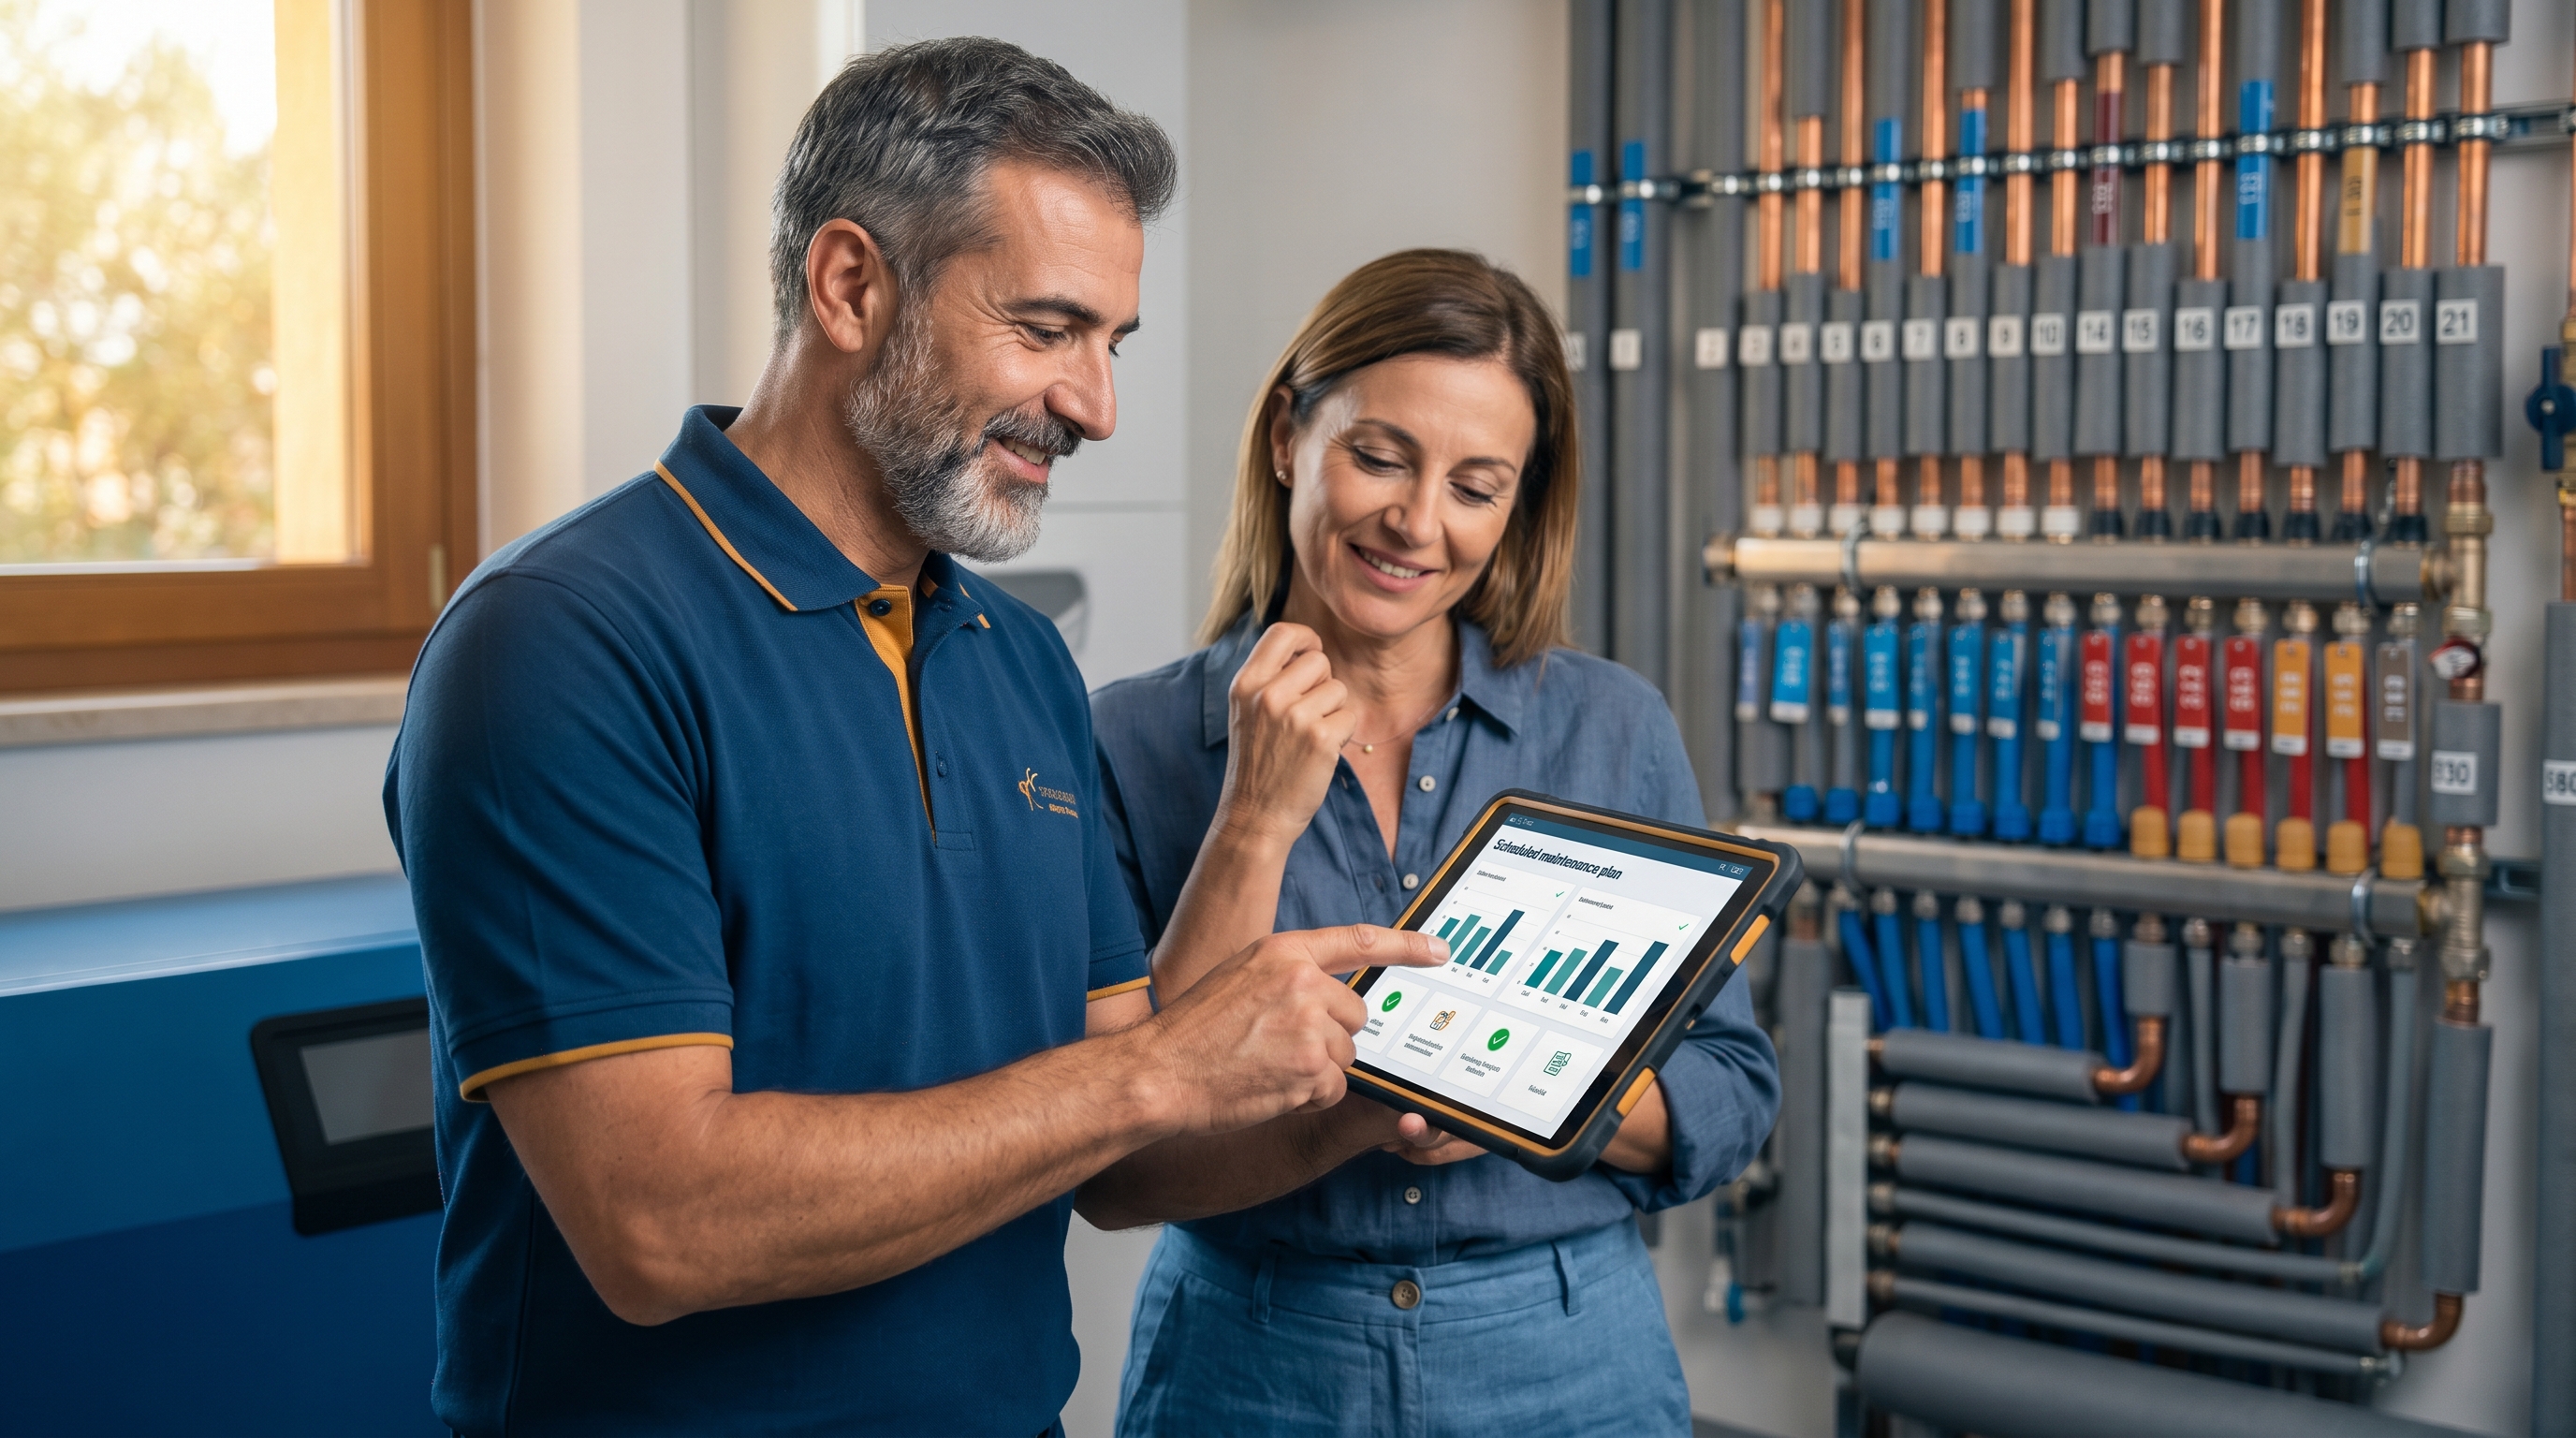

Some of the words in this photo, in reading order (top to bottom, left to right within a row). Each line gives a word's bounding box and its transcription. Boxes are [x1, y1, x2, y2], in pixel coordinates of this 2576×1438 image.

[2038, 319, 2057, 346] 10
[2085, 317, 2107, 343] 14
[2129, 315, 2150, 344] 15
[2184, 315, 2205, 343] 16
[2231, 312, 2256, 340] 17
[2281, 310, 2308, 340] 18
[2334, 308, 2360, 336] 19
[2387, 307, 2413, 337] 20
[2442, 308, 2469, 336] 21
[1493, 838, 1543, 860] Scheduled
[1596, 865, 1623, 880] plan
